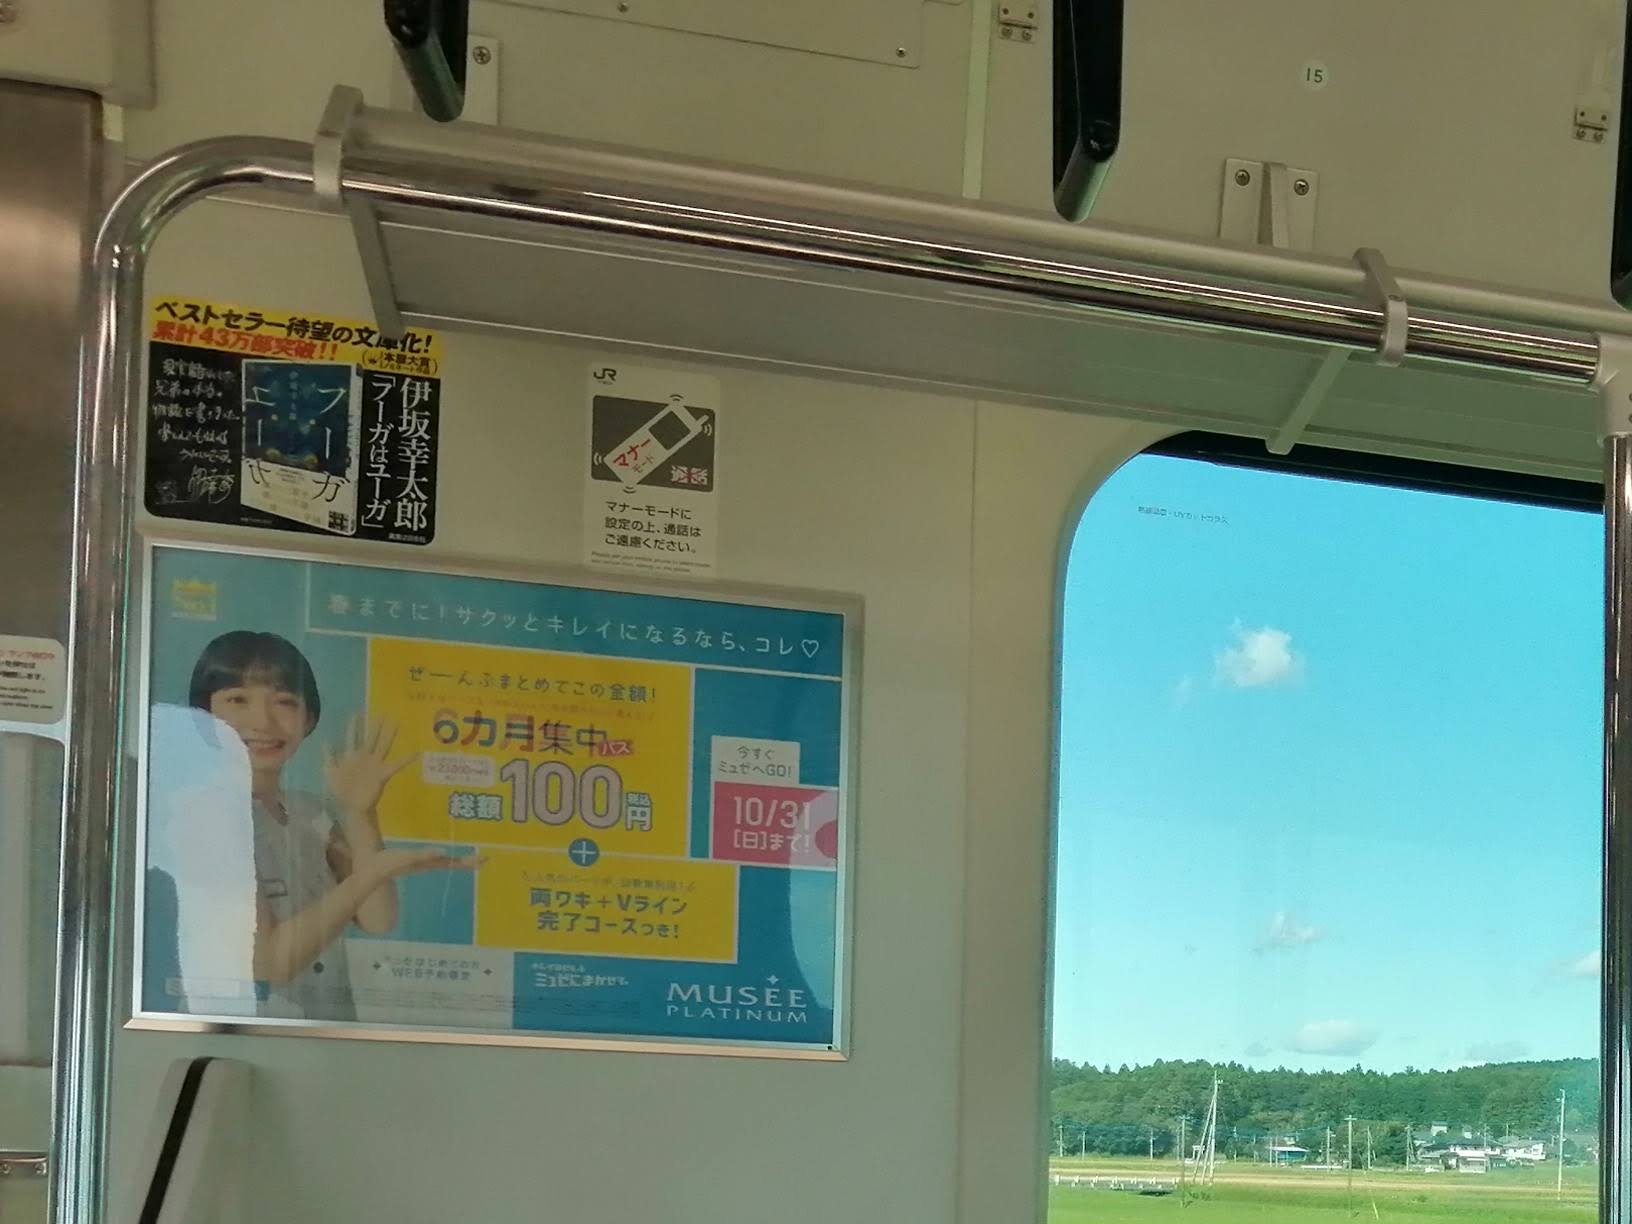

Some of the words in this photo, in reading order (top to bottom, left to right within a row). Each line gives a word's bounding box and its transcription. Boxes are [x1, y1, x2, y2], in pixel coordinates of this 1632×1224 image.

[1307, 67, 1323, 83] 15
[593, 367, 617, 381] JR
[361, 374, 397, 529] 「フーガはユーガ」
[393, 377, 433, 532] 伊坂幸太郎
[613, 438, 652, 467] マナー
[605, 501, 693, 520] マナーモードに
[605, 517, 701, 538] 設定の上、通話は
[605, 534, 697, 554] ご遠慮ください。
[737, 745, 775, 761] 今すぐ
[718, 760, 793, 779] ミュゼへGO!
[733, 795, 811, 830] 10/31
[666, 1004, 809, 1024] PLATINUM
